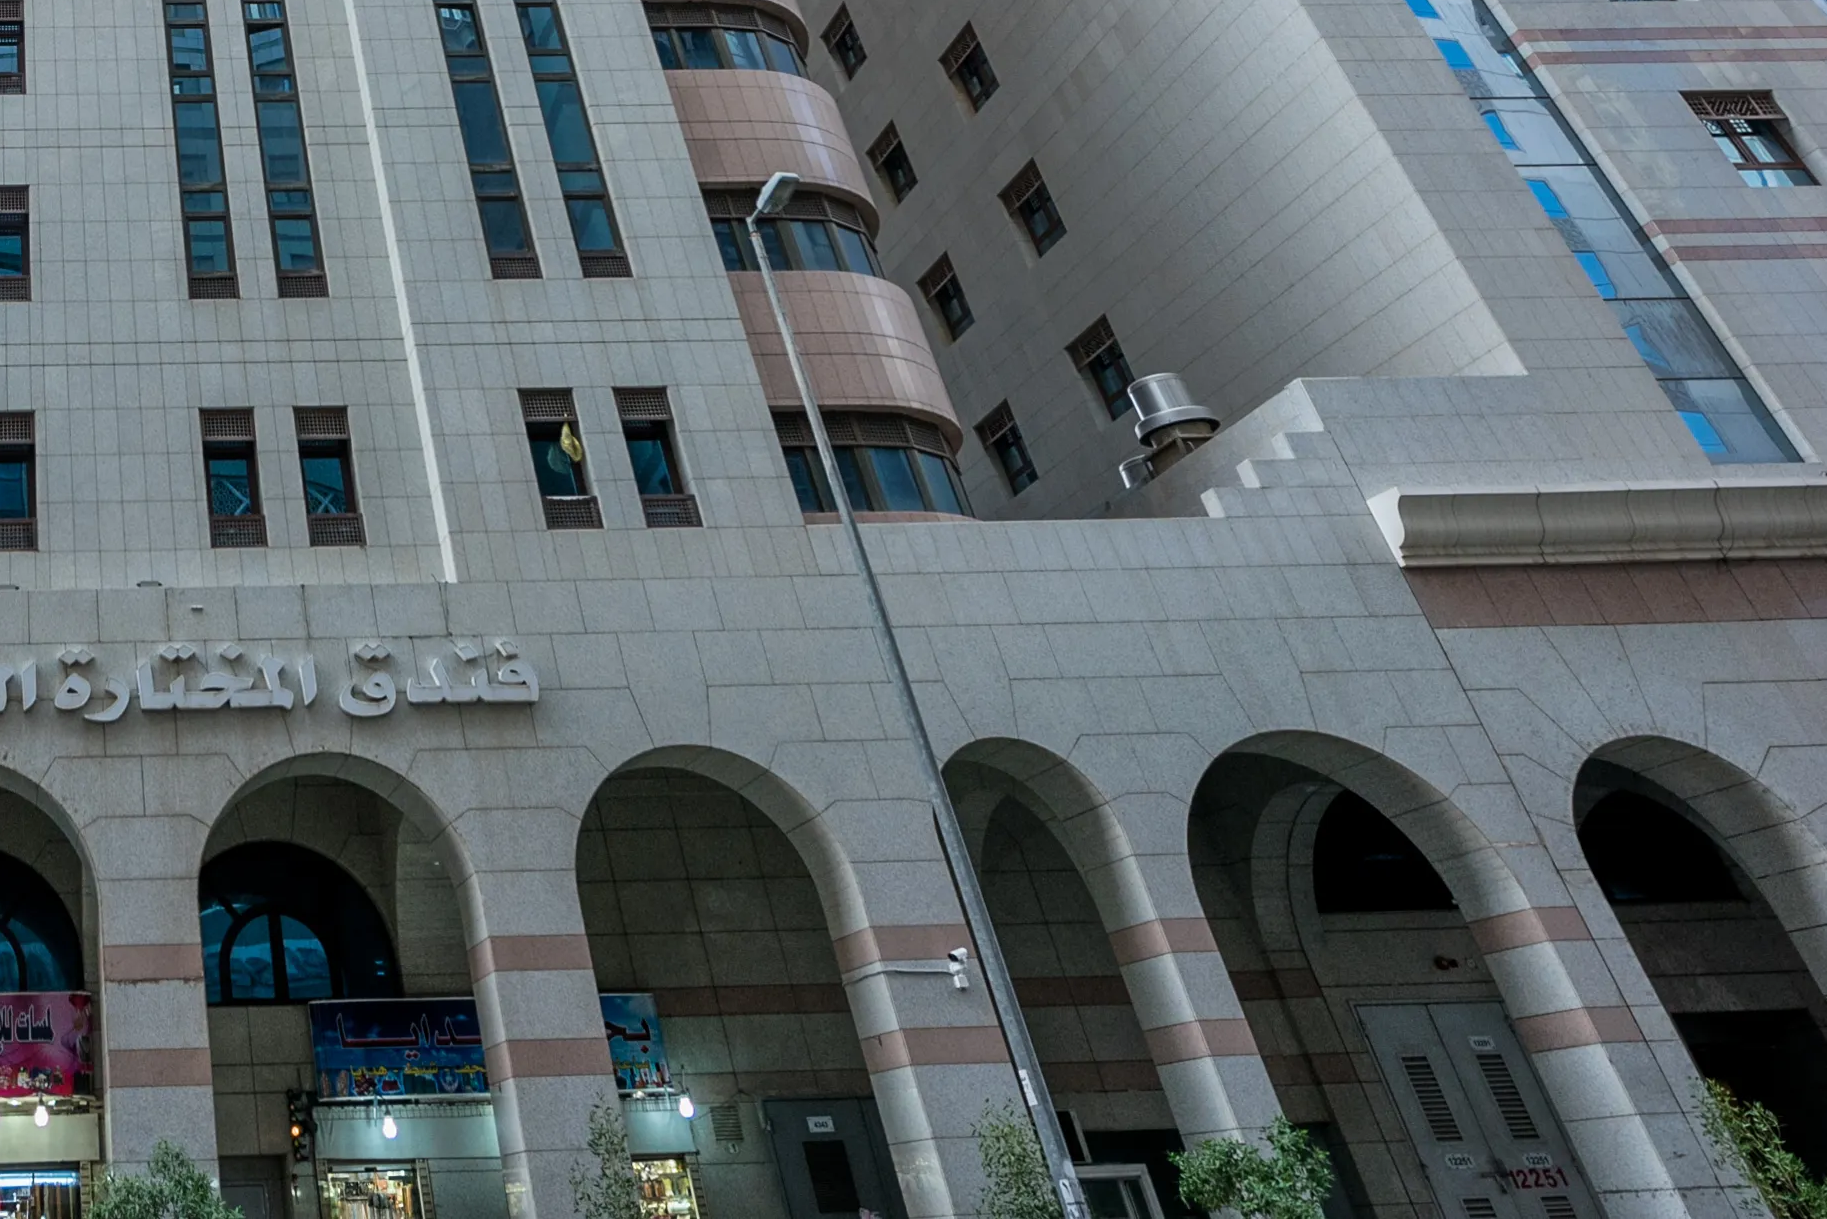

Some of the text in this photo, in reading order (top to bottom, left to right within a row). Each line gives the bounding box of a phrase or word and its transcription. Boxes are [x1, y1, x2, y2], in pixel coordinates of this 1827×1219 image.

[53, 643, 317, 724] المختارة
[338, 639, 540, 718] فندق
[14, 1004, 55, 1044] لمسات
[1447, 1156, 1474, 1167] 12251
[1525, 1154, 1550, 1166] 12251
[1508, 1166, 1570, 1190] 12251
